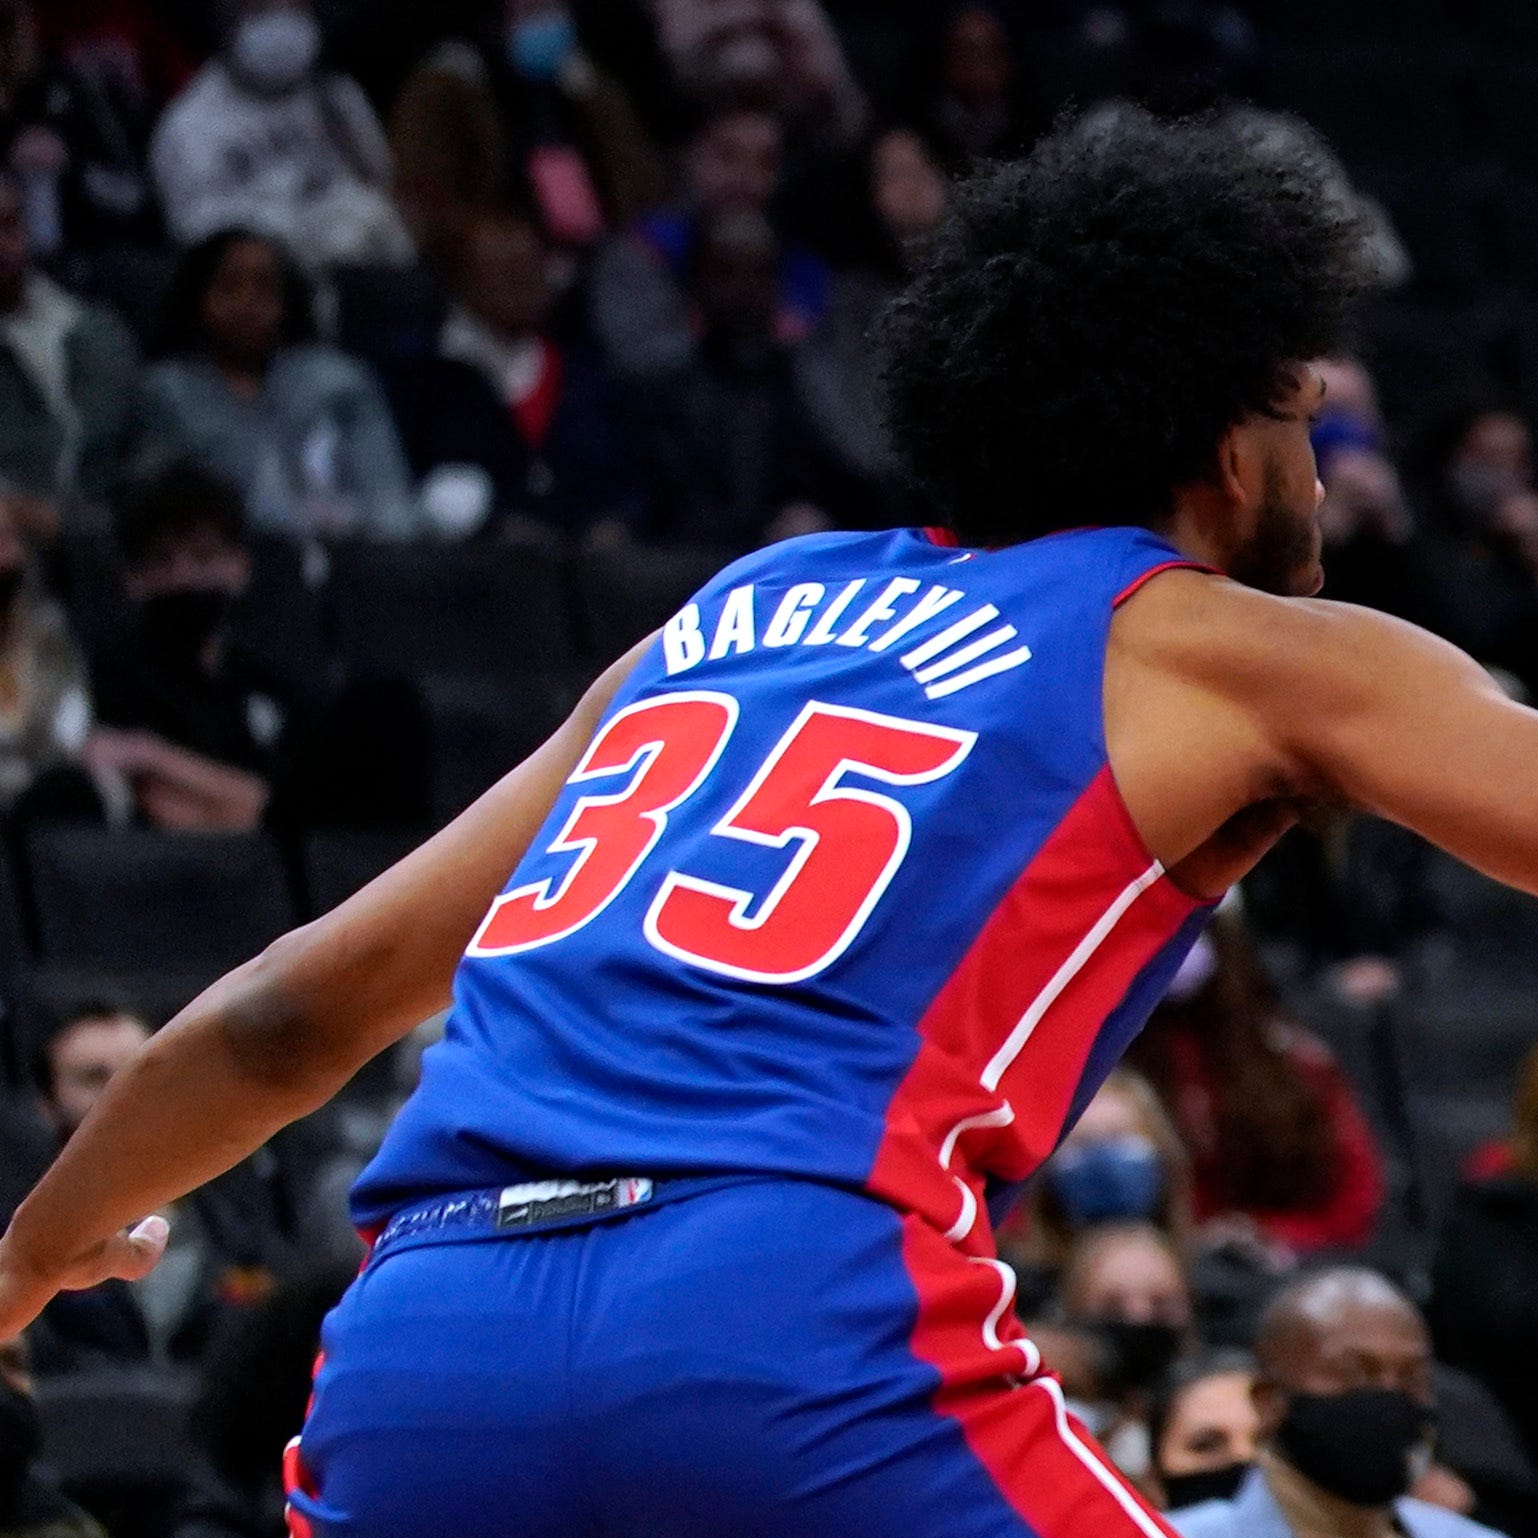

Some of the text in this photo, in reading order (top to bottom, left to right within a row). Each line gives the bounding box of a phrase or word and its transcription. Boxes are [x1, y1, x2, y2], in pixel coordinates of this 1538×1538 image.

[663, 577, 1032, 700] BAGLEY III
[465, 690, 978, 985] 35
